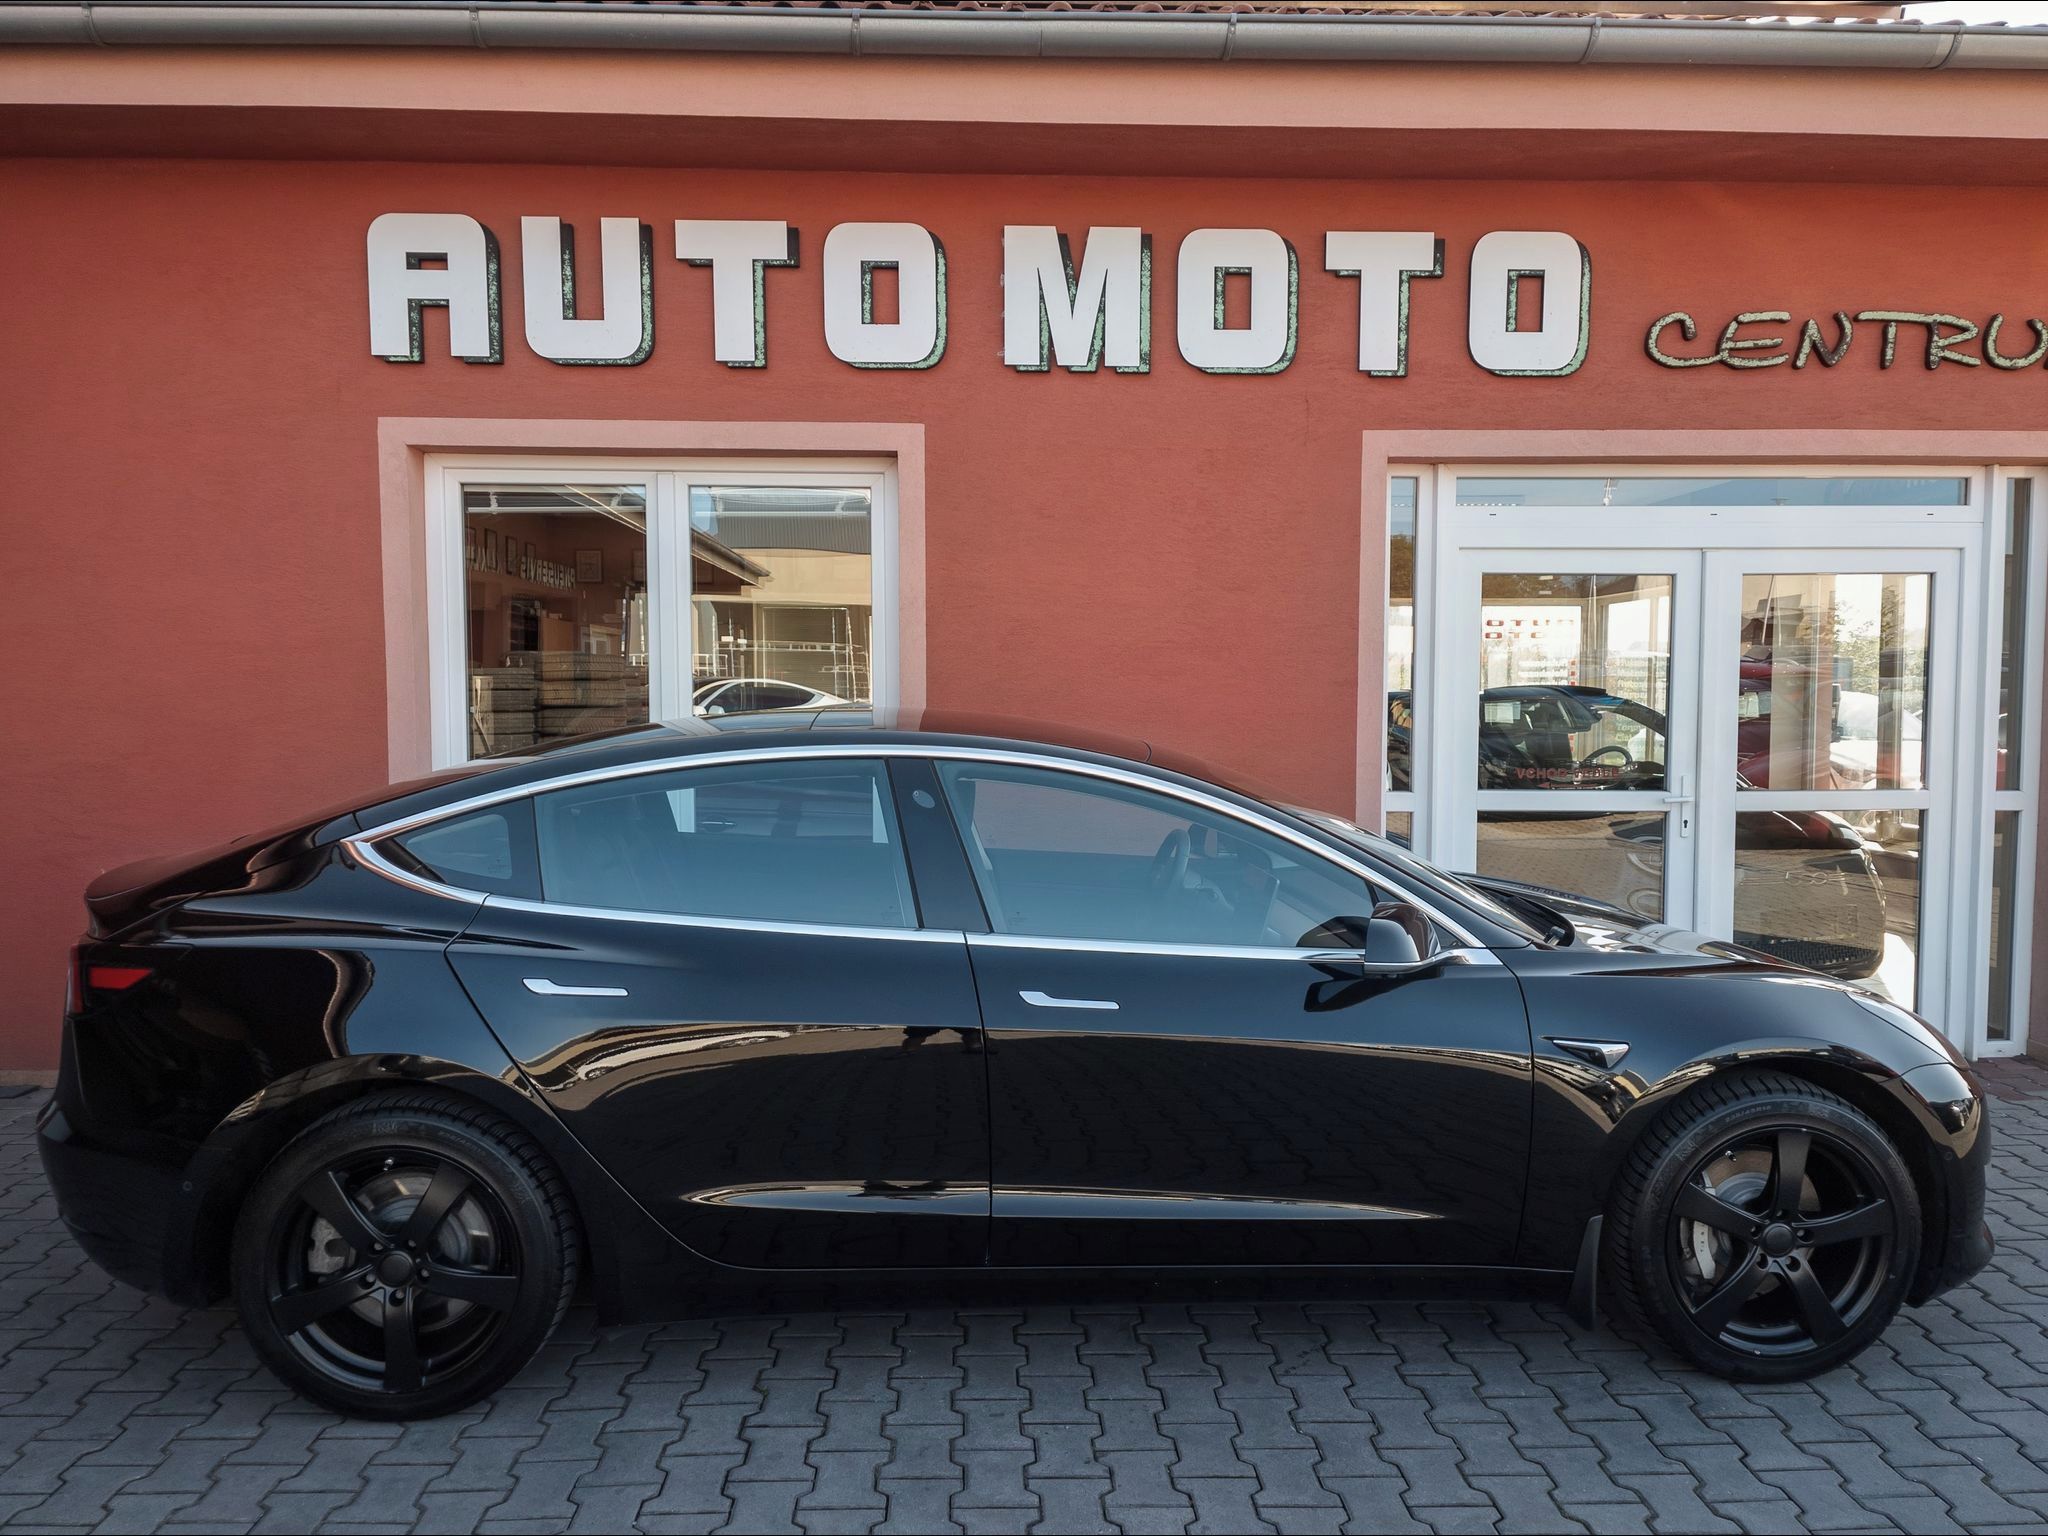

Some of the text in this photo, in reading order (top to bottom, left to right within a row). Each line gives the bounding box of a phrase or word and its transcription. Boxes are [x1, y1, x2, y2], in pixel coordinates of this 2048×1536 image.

[366, 212, 2048, 378] AUTO MOTO CENTRU
[1515, 767, 1569, 780] VCHOD
